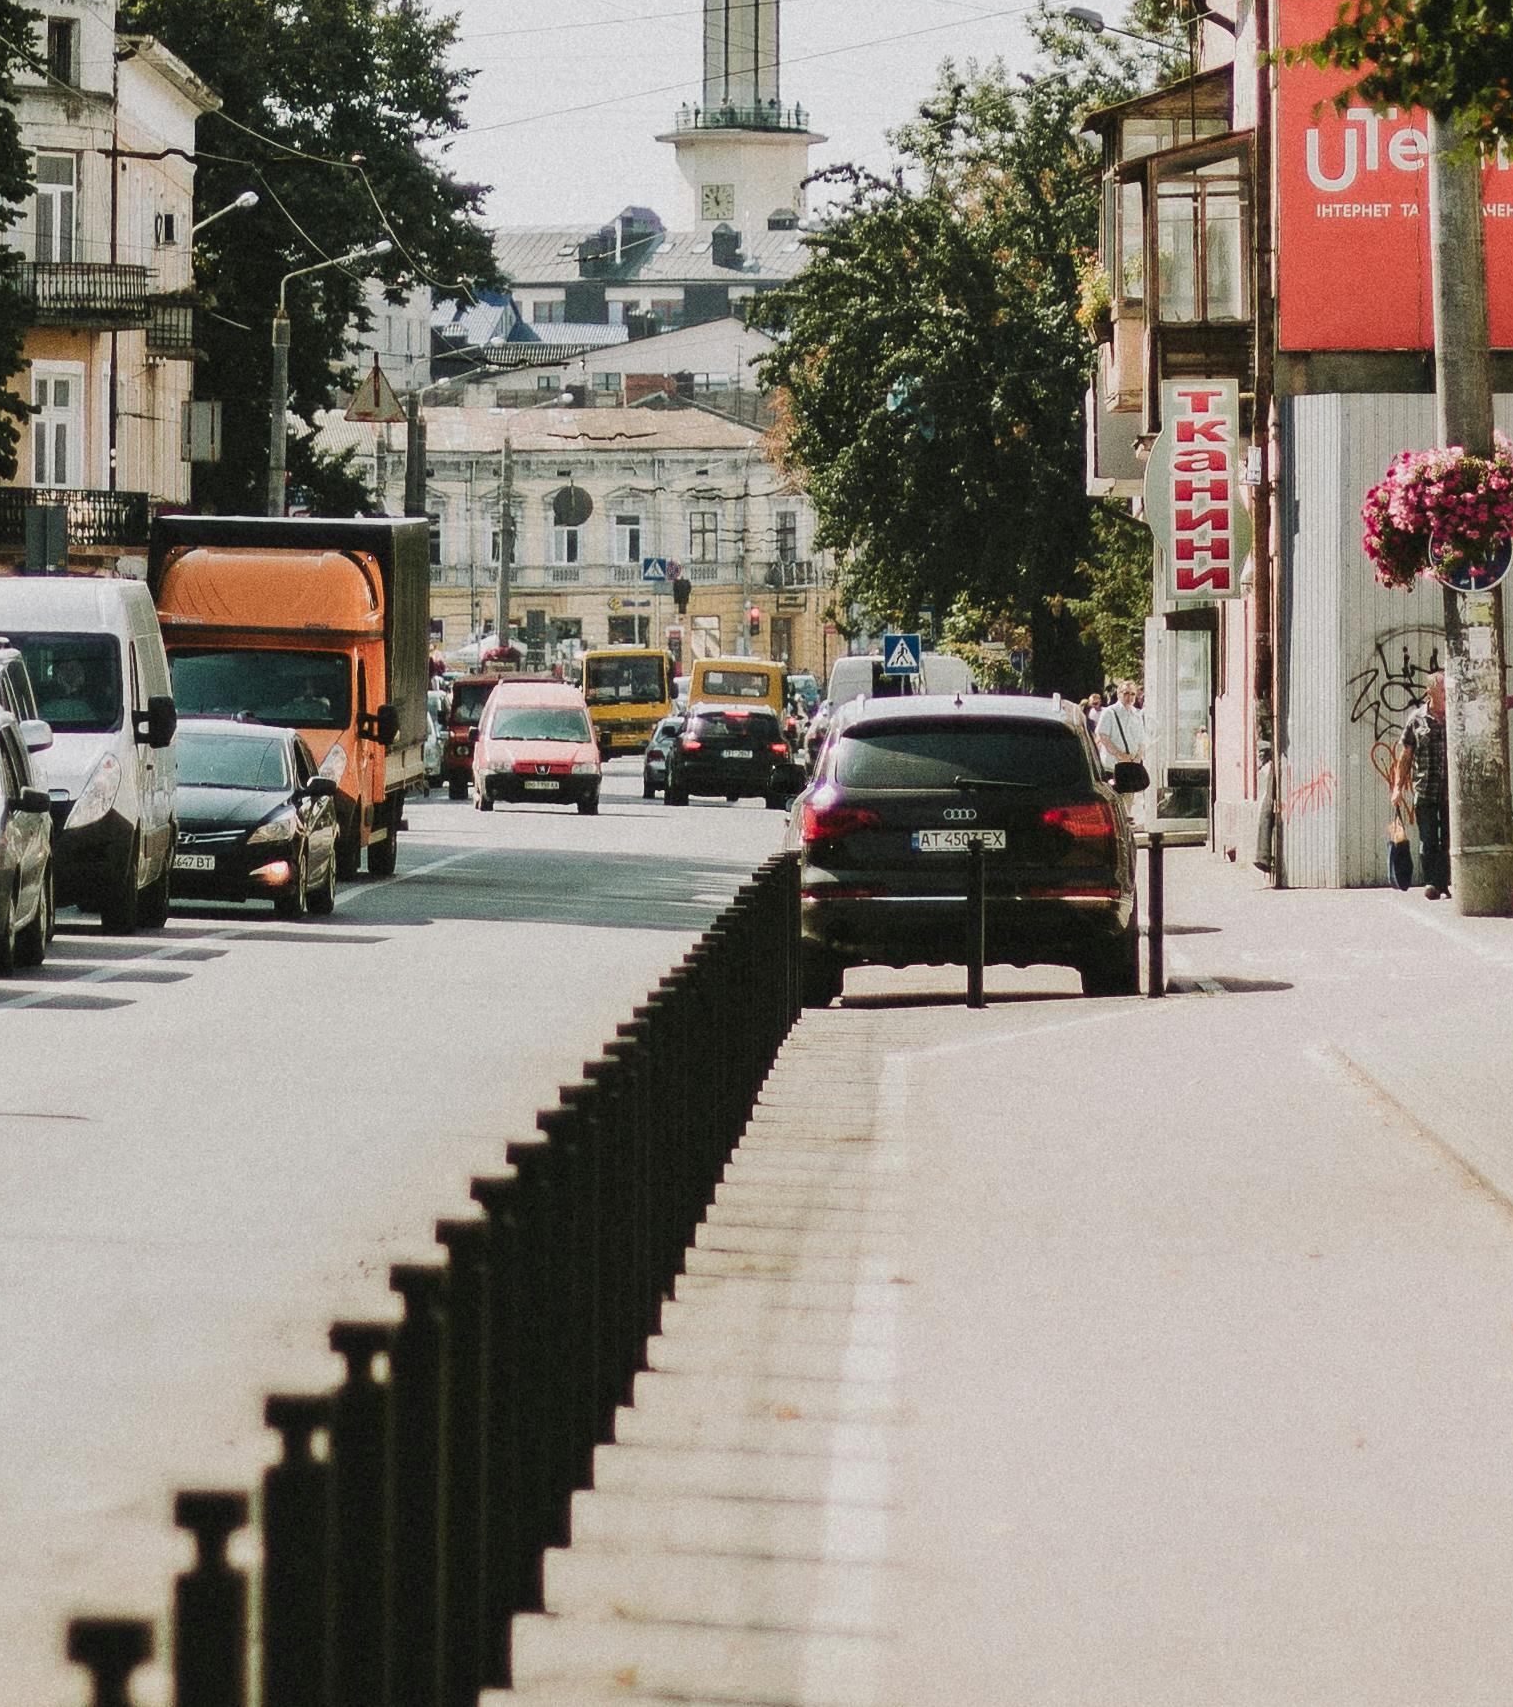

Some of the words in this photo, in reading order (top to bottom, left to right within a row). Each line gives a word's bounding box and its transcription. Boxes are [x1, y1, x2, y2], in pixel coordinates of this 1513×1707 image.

[1316, 203, 1391, 217] ІНТЕРНЕТ
[1400, 203, 1420, 217] ТА
[921, 832, 940, 846] AT
[983, 832, 1003, 846] EX
[196, 857, 212, 868] BT
